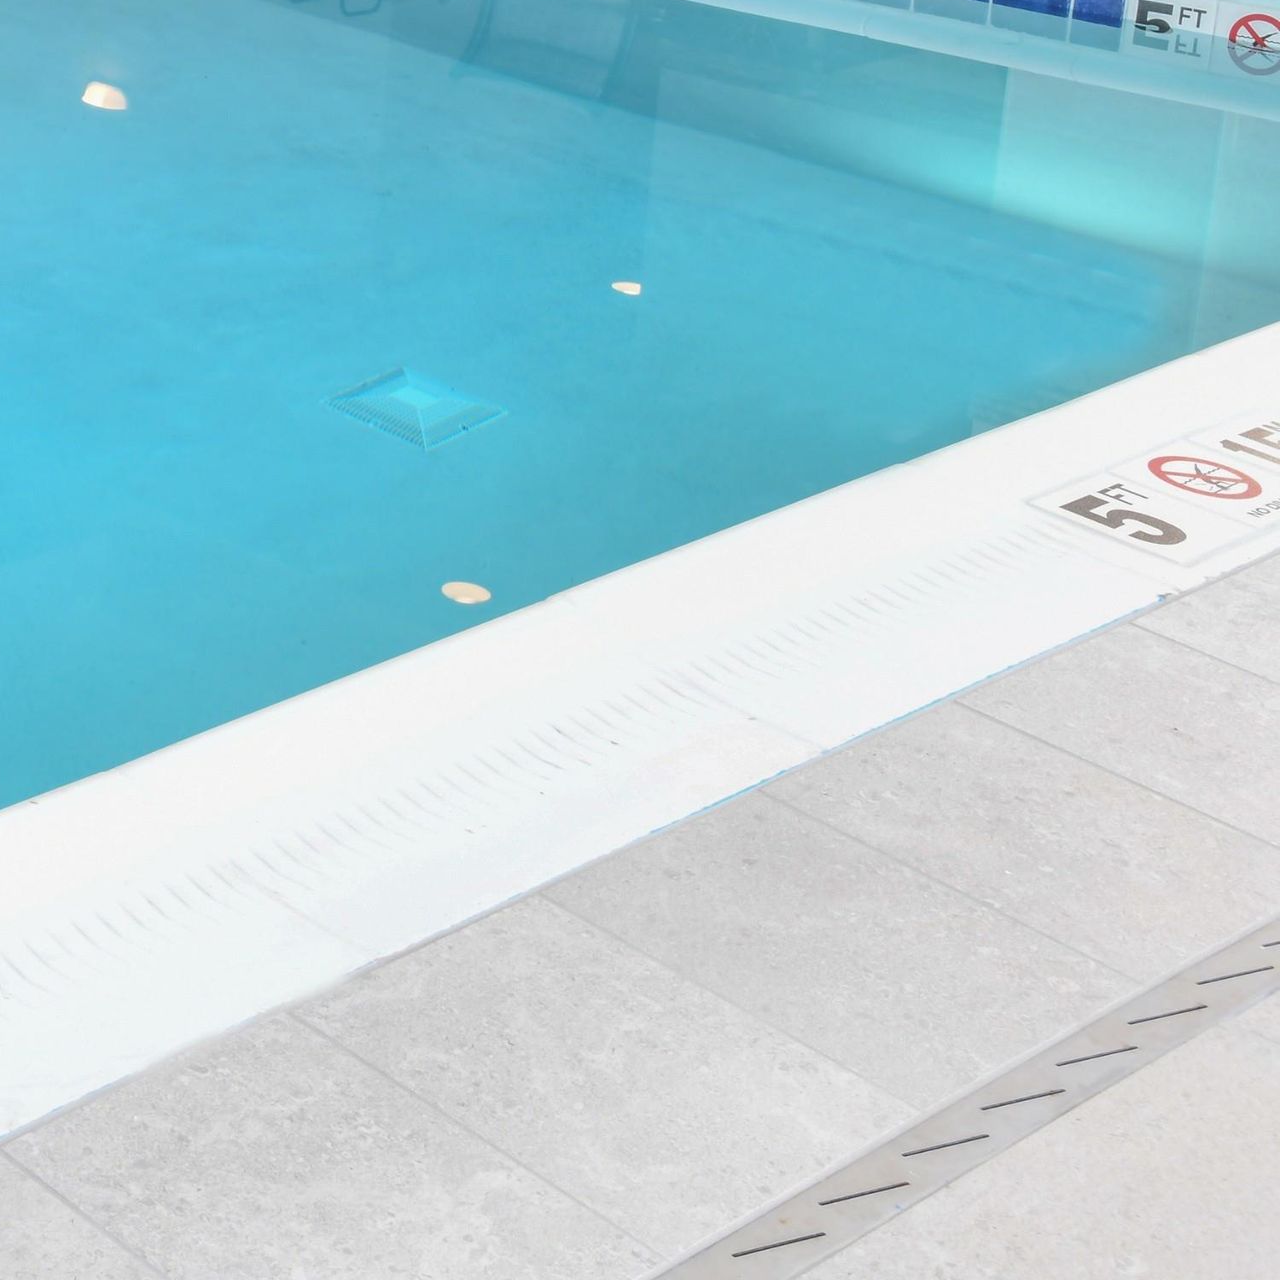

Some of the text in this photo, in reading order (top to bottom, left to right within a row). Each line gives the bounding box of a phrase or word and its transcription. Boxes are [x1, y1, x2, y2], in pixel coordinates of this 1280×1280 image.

[1178, 6, 1207, 29] FT
[1059, 483, 1187, 545] 5 FT
